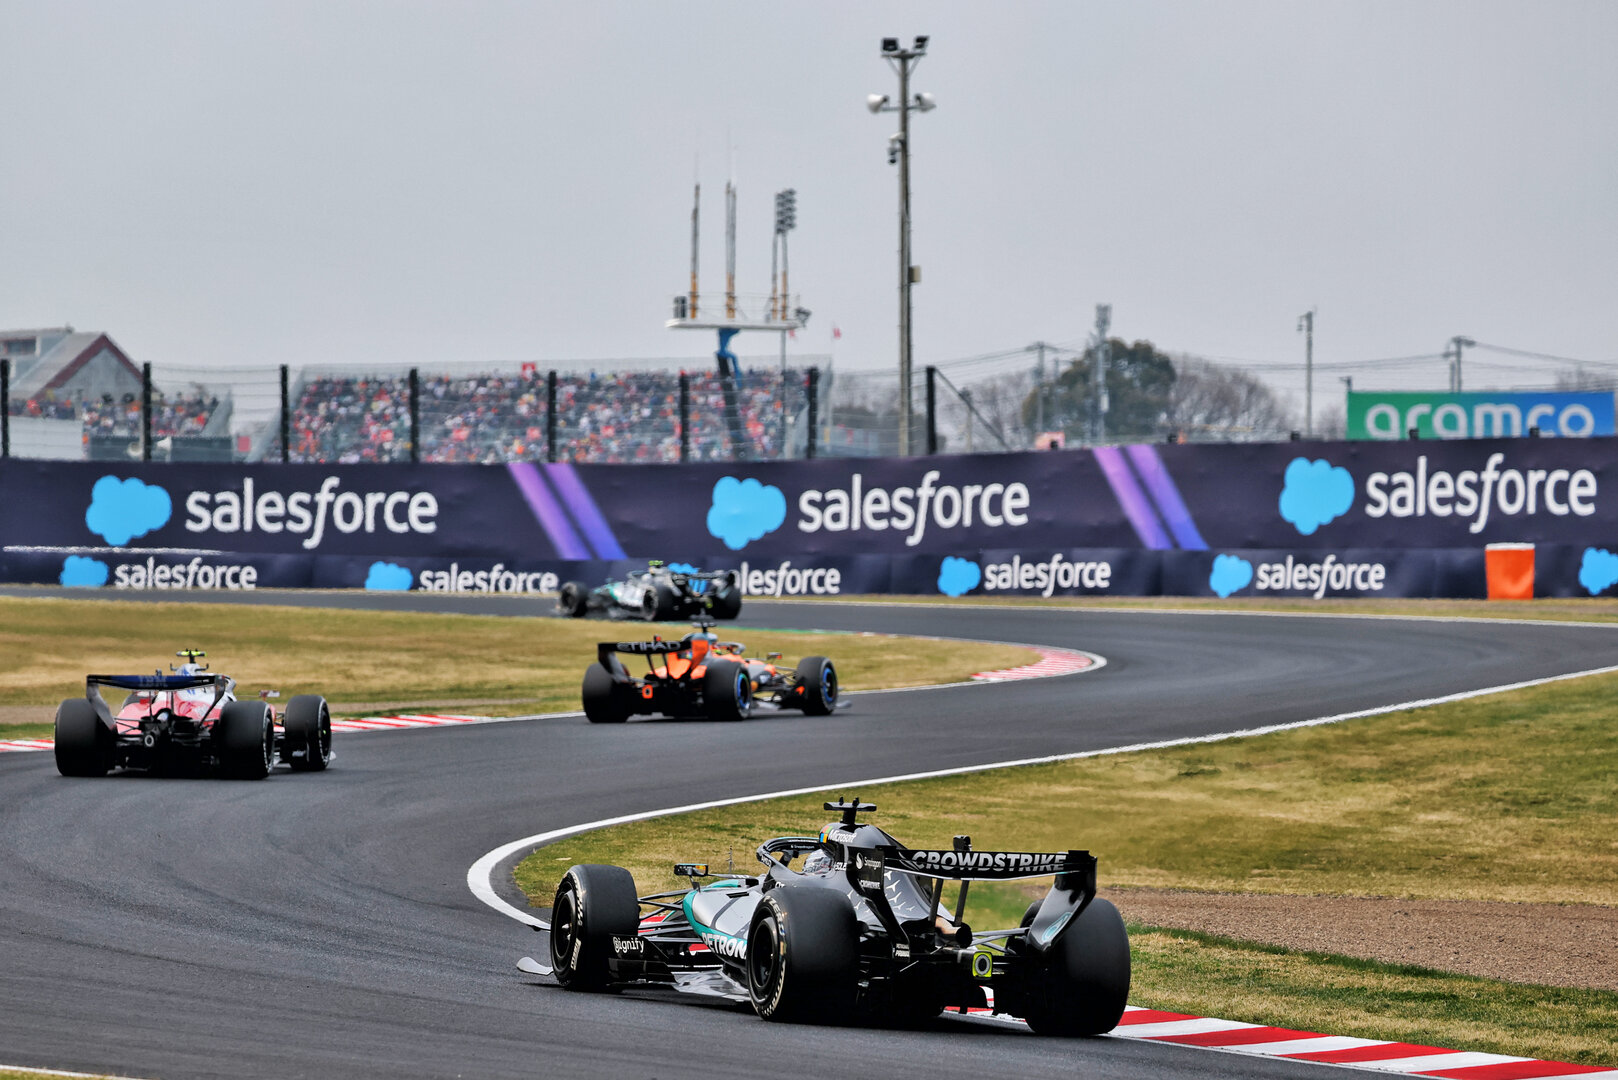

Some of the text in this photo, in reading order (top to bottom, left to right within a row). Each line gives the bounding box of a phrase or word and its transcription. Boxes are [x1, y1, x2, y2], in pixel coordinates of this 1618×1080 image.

[1366, 403, 1595, 439] aramco
[798, 470, 1030, 546] salesforce
[1365, 452, 1597, 533] salesforce
[184, 476, 439, 550] salesforce
[114, 556, 258, 590] salesforce
[419, 562, 559, 592] salesforce
[984, 553, 1112, 598] salesforce
[1255, 554, 1386, 600] salesforce
[616, 641, 681, 652] ETIHAD
[911, 851, 1068, 872] CROWDSTRIKE
[701, 932, 747, 960] PETRON
